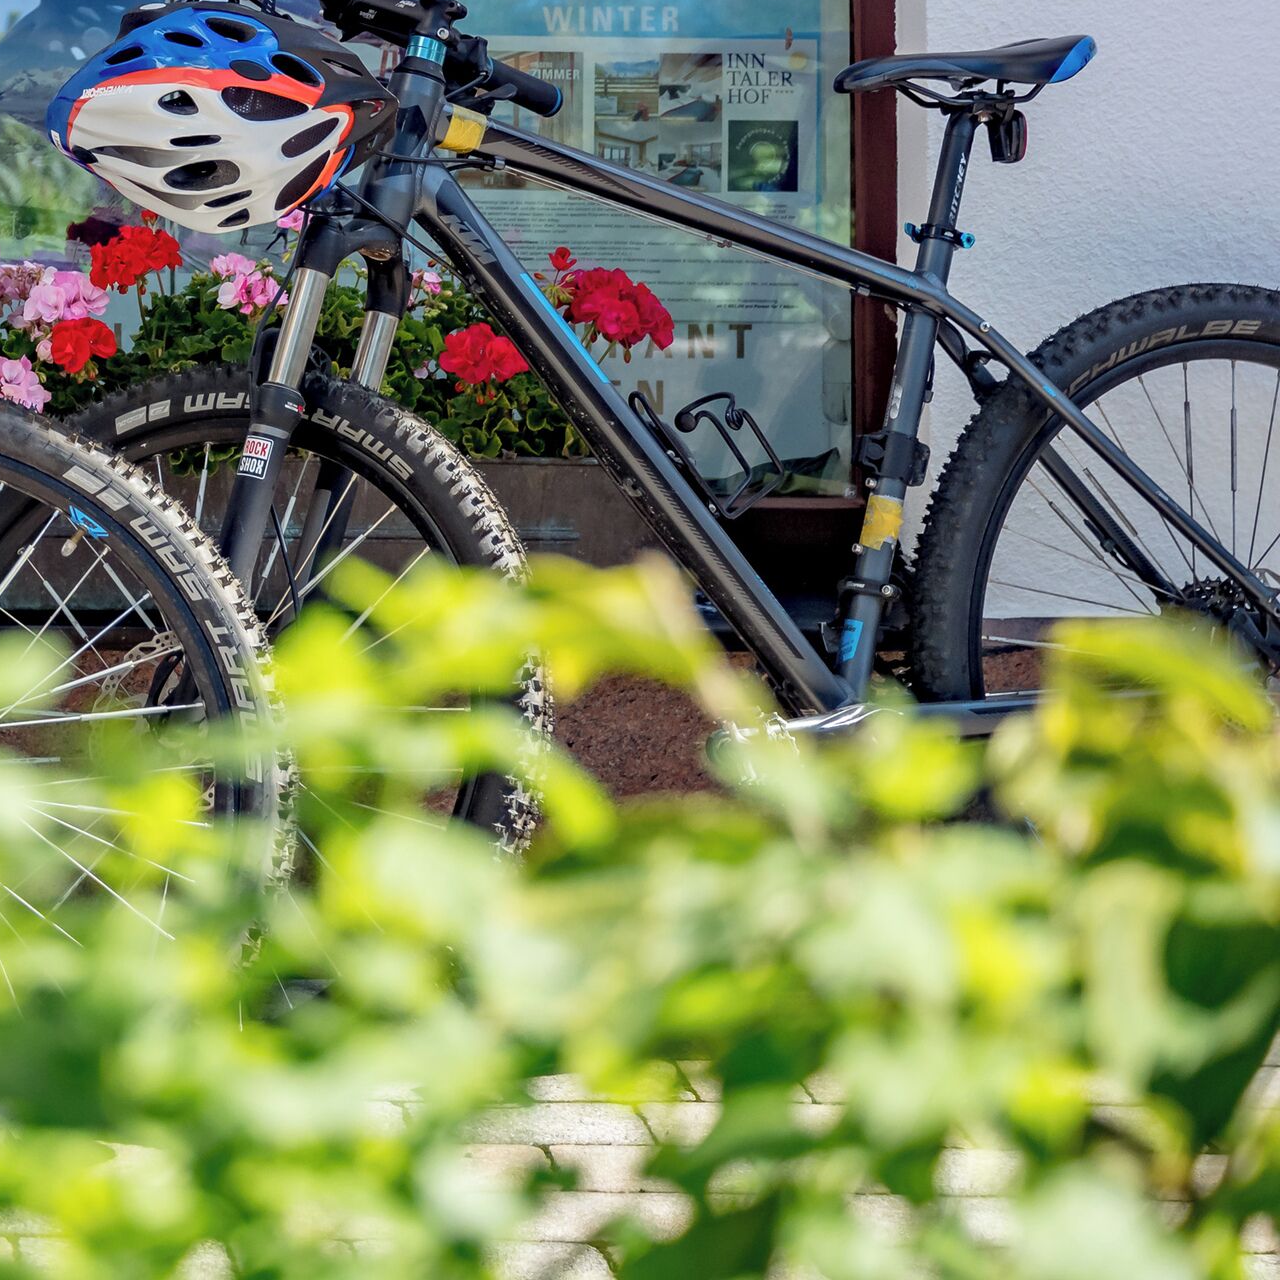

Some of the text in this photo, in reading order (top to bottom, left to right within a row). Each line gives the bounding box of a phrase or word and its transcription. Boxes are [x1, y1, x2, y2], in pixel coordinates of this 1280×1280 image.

[543, 5, 680, 32] WINTER
[726, 53, 766, 69] INN
[529, 68, 580, 80] ZIMMER
[726, 70, 794, 87] TALER
[726, 88, 772, 105] HOF
[949, 152, 969, 226] RITCHEY
[1065, 319, 1263, 397] CHWALBE
[245, 440, 269, 457] ROCK
[240, 457, 265, 475] SHOX
[130, 515, 208, 602] SAM
